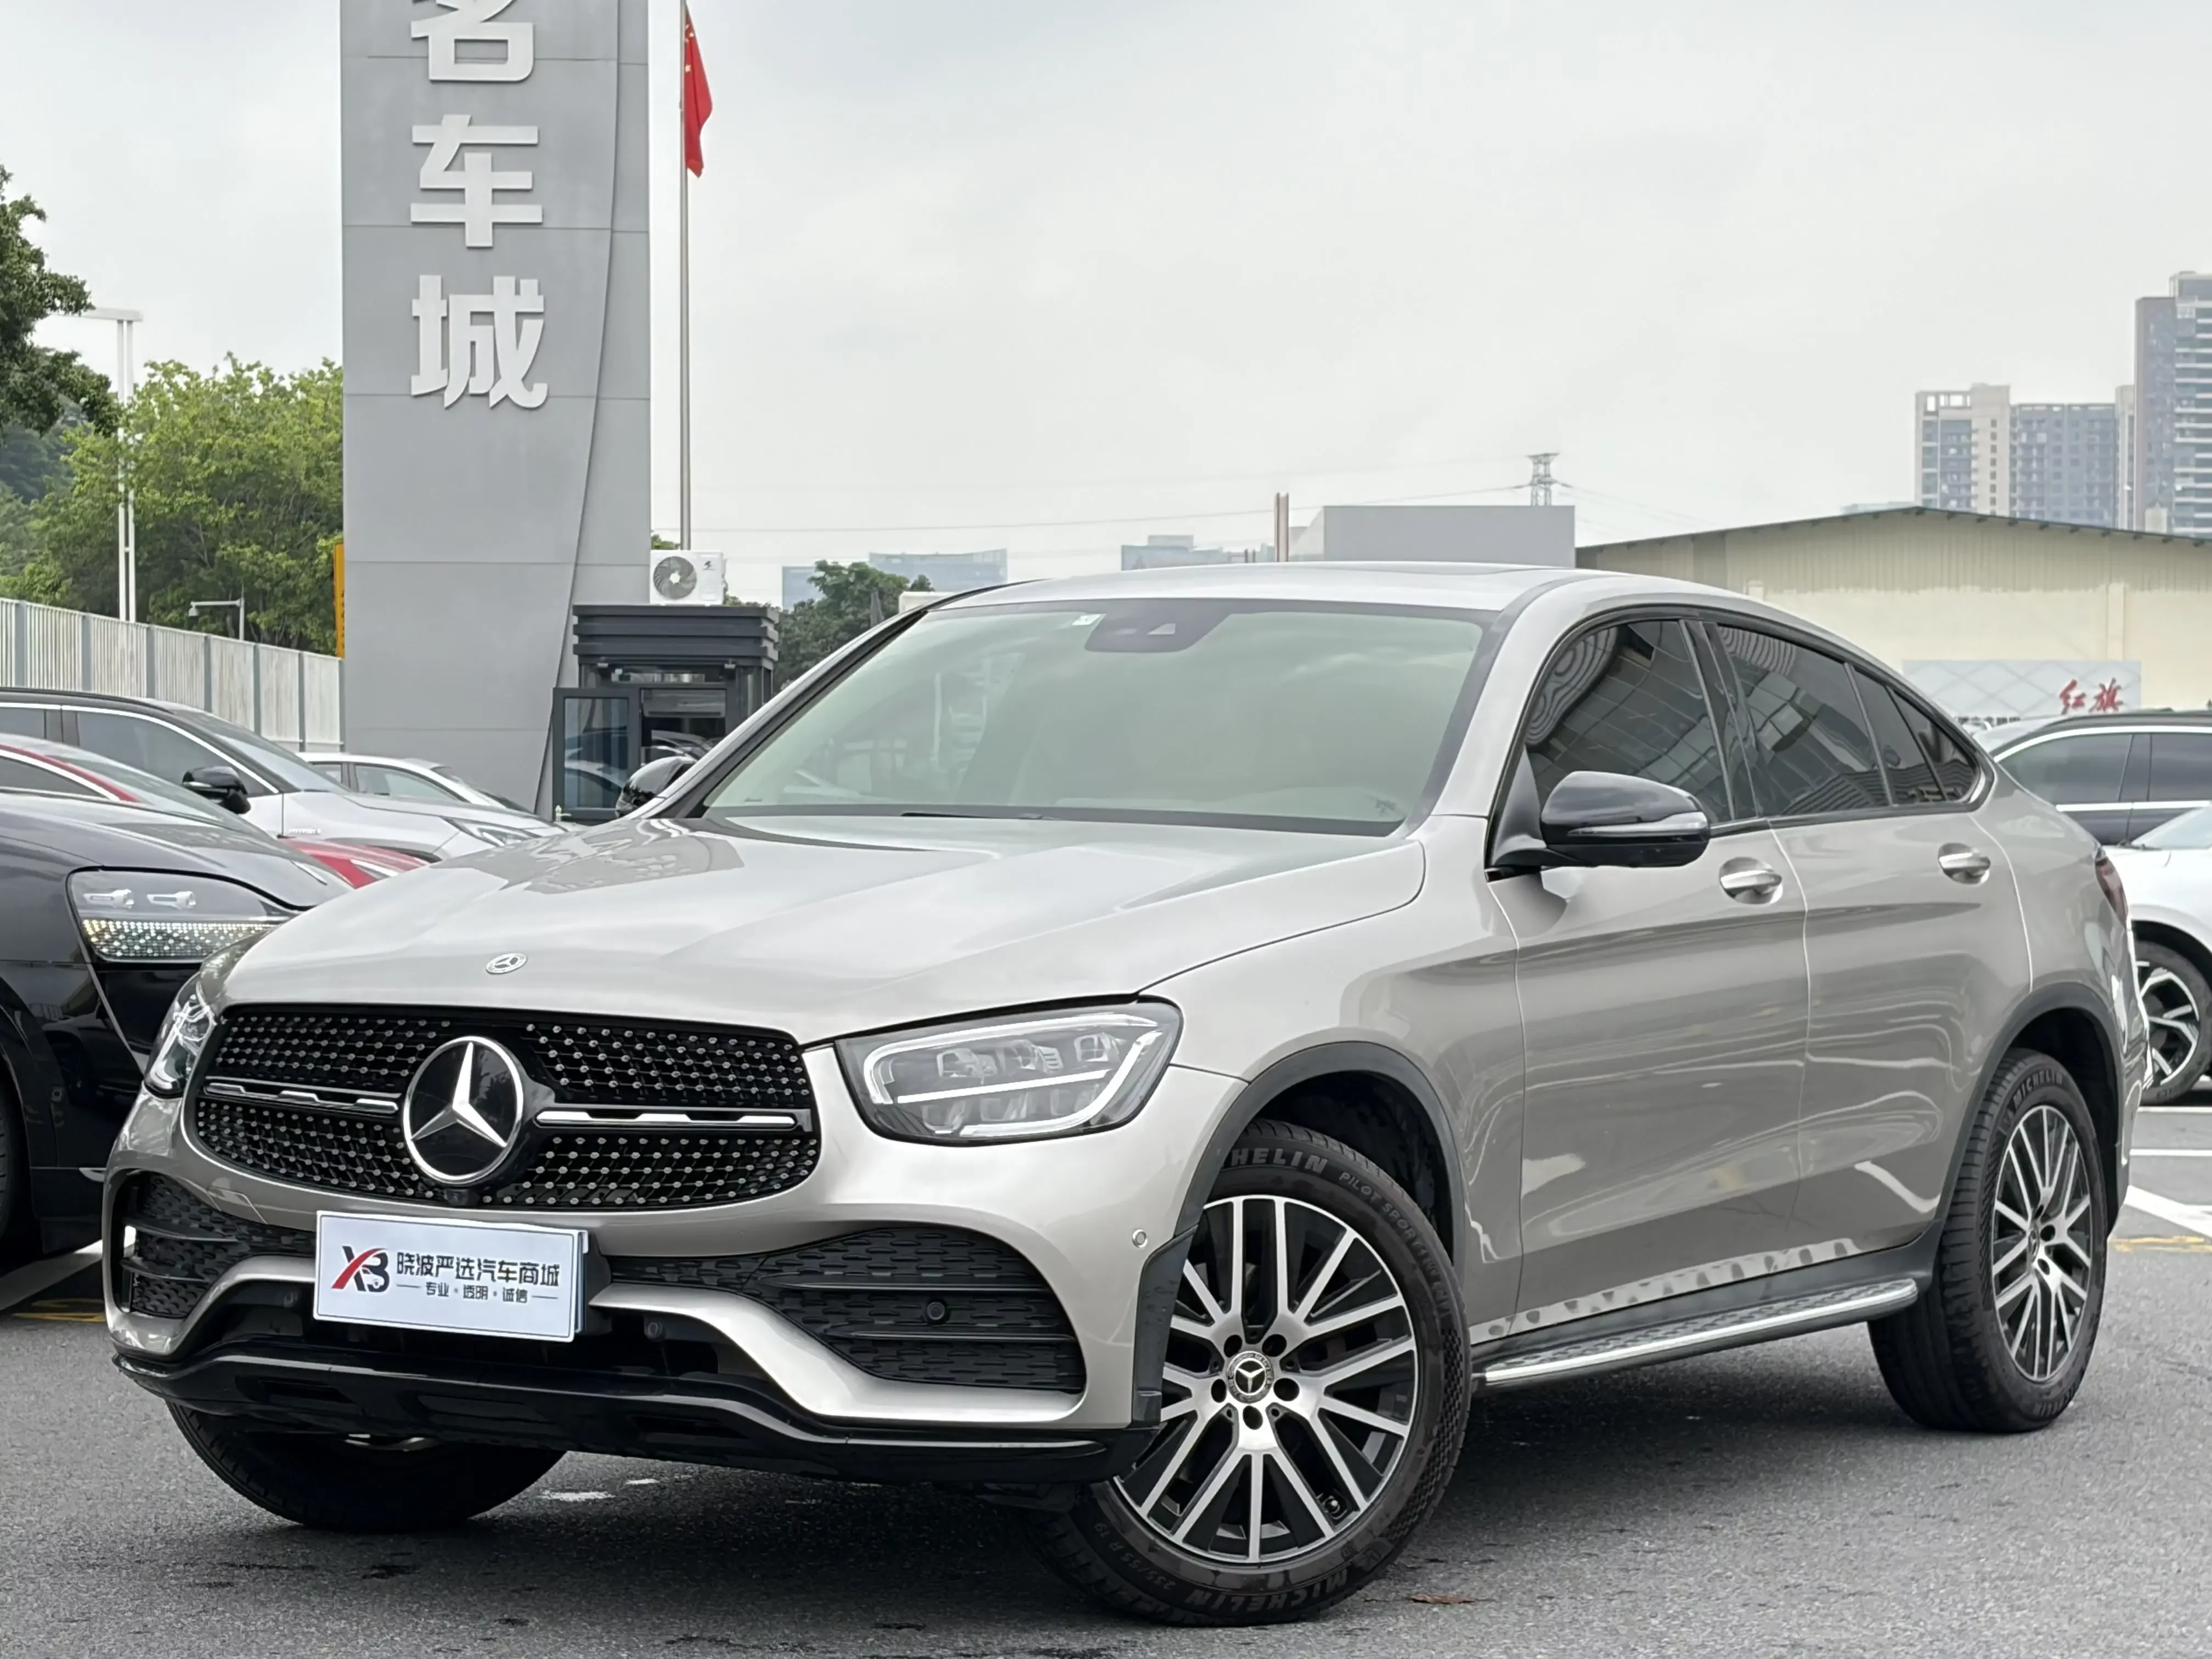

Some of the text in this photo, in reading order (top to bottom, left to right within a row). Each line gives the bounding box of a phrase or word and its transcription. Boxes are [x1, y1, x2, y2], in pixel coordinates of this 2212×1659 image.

[1231, 1147, 1328, 1174] HELIN
[1339, 1171, 1383, 1205] PILOT
[396, 1251, 560, 1286] 晓波严选汽车商城
[1184, 1567, 1349, 1612] MICHELIN
